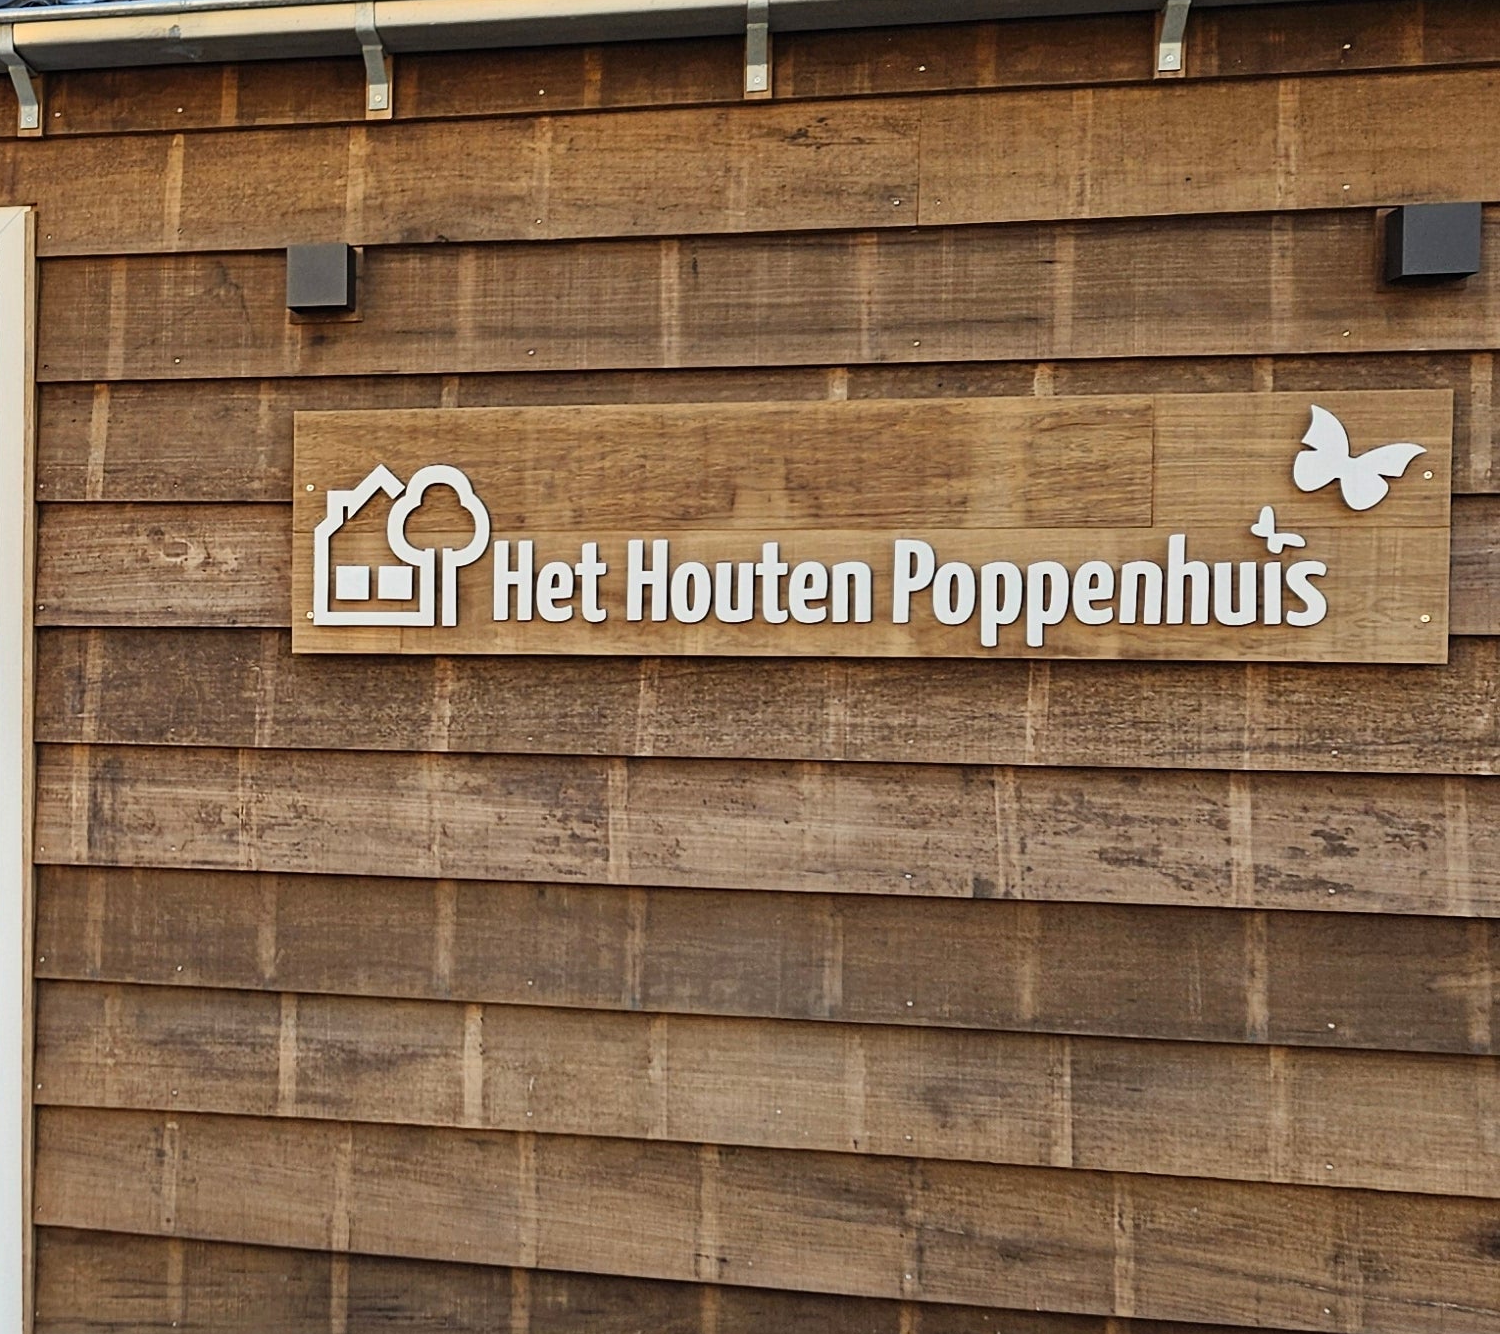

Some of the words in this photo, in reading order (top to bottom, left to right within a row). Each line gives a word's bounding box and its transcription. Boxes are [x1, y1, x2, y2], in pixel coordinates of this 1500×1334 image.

[492, 539, 607, 623] Het
[626, 539, 872, 624] Houten
[891, 533, 1328, 647] Poppenhuis
